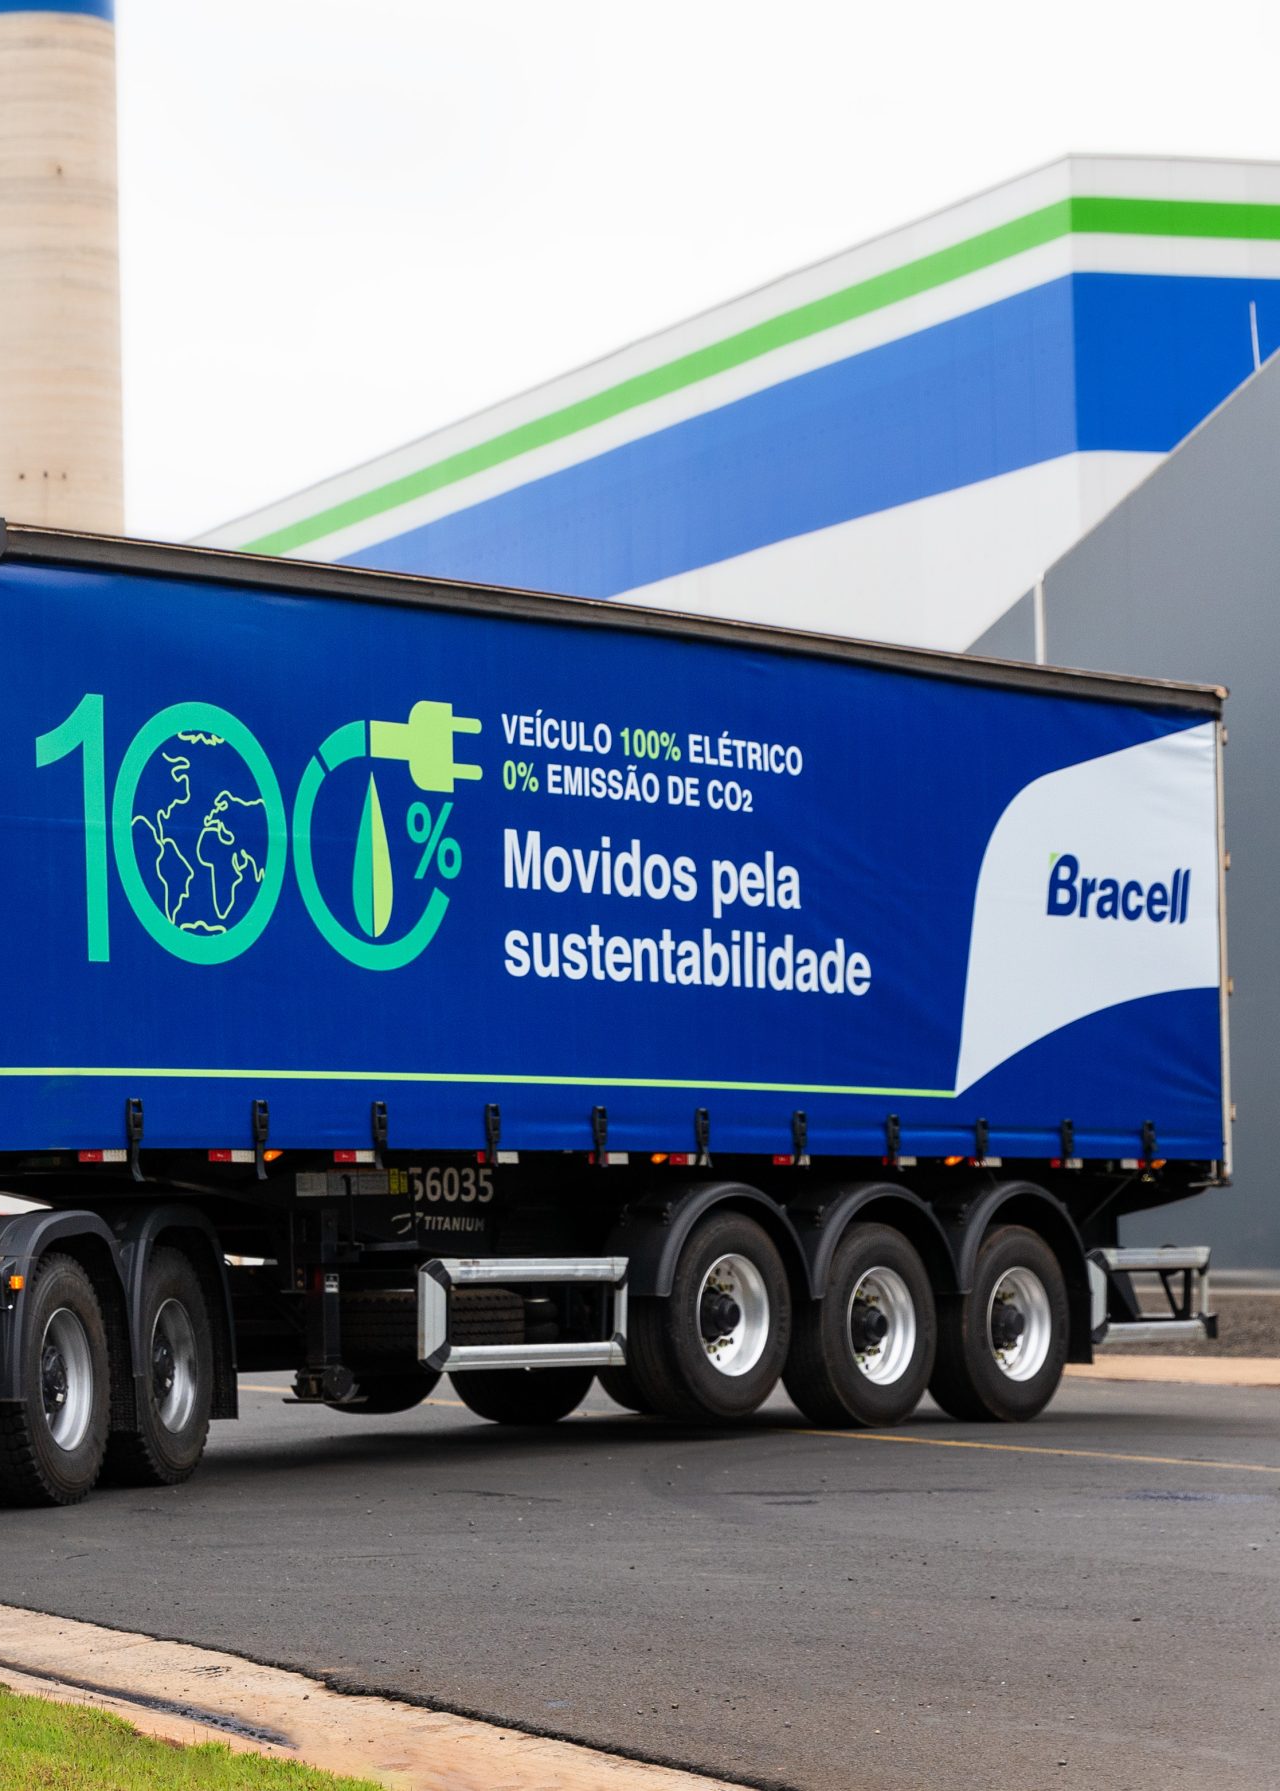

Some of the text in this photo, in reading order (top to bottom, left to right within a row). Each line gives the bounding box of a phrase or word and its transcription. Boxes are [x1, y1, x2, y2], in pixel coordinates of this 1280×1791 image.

[501, 709, 804, 776] VEÍCULO 100% ELÉTRICO
[503, 760, 539, 792] 0%
[547, 764, 660, 803] EMISSÃO
[667, 775, 701, 807] DE
[504, 828, 801, 919] Movidos pela
[1047, 853, 1191, 924] Bracell
[504, 924, 872, 996] sustentabilidade
[423, 1216, 485, 1232] TITANIUM
